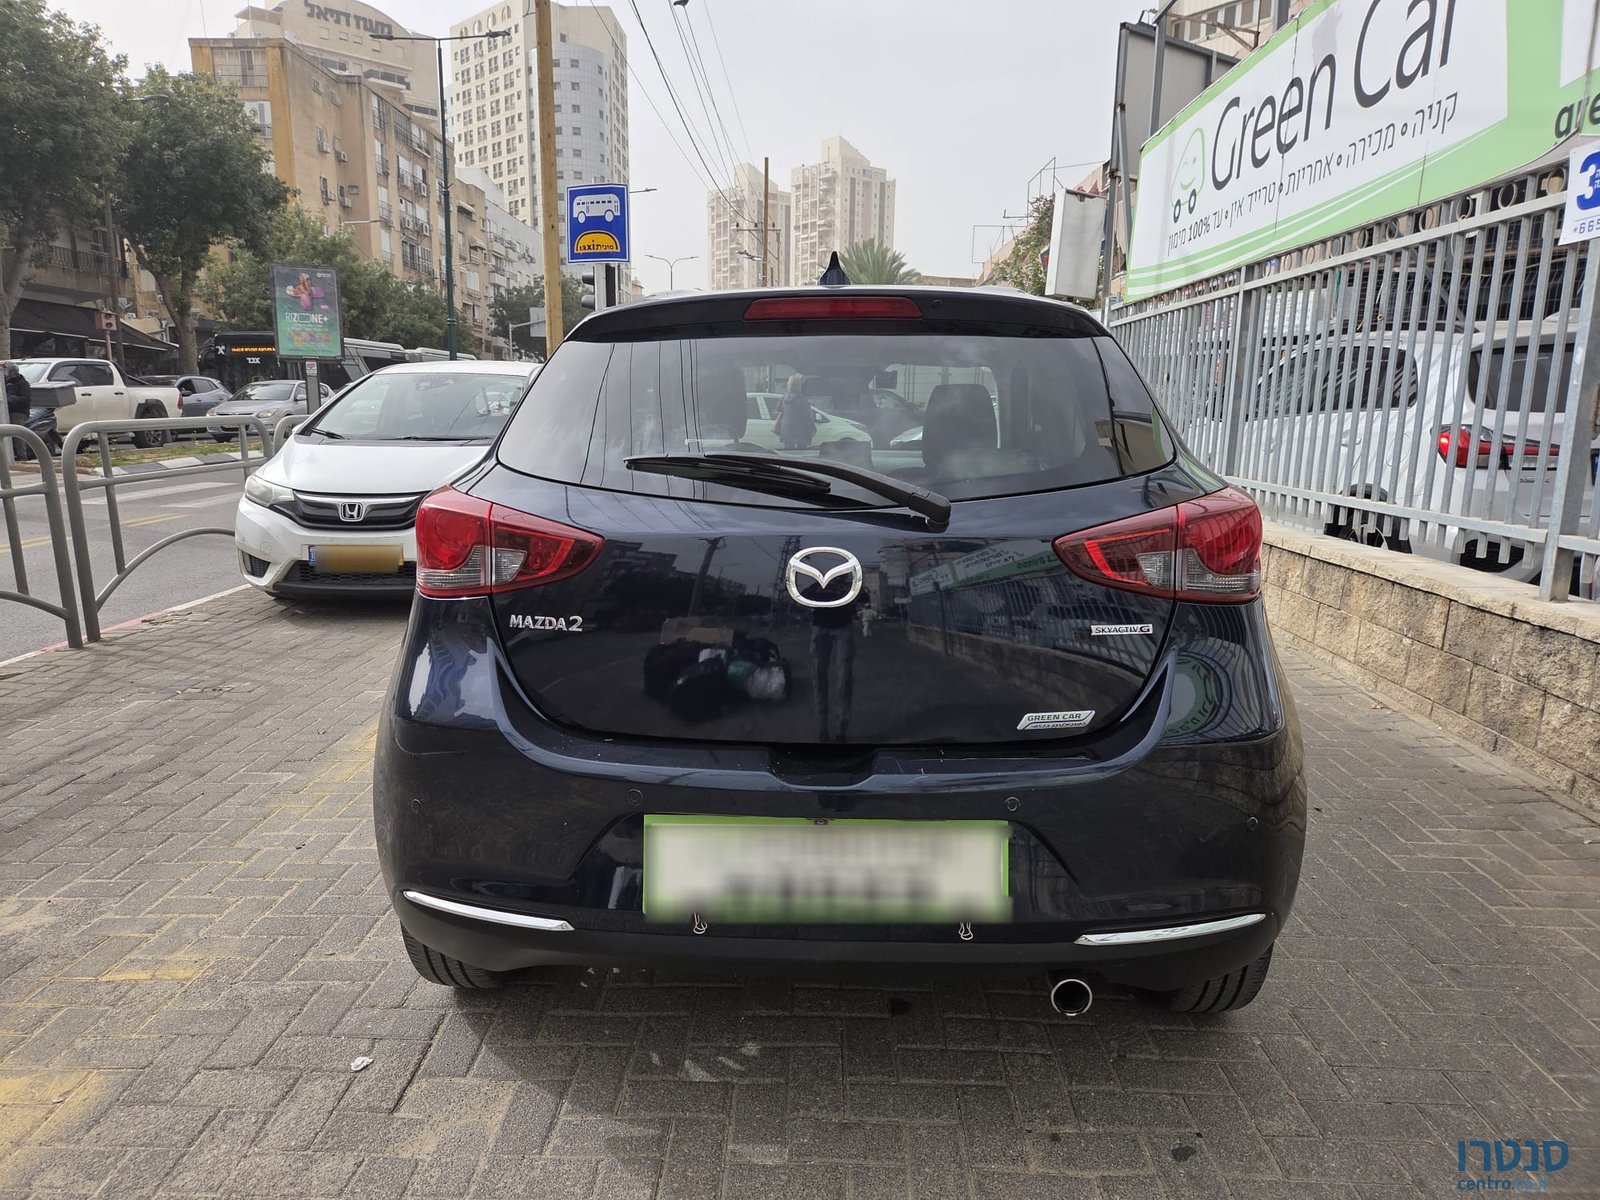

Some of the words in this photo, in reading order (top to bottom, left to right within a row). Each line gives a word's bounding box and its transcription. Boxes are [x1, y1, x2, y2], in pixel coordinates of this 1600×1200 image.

[1211, 54, 1336, 191] Green
[1411, 91, 1458, 138] קניה
[1345, 122, 1396, 169] מכירה
[1285, 152, 1334, 196] אחריות
[1229, 196, 1245, 228] אין
[1247, 181, 1276, 212] טרייד
[1187, 214, 1211, 242] 100%
[1212, 208, 1224, 230] עד
[579, 240, 595, 251] taxi
[1027, 714, 1060, 722] GREEN
[1062, 712, 1081, 720] CAR
